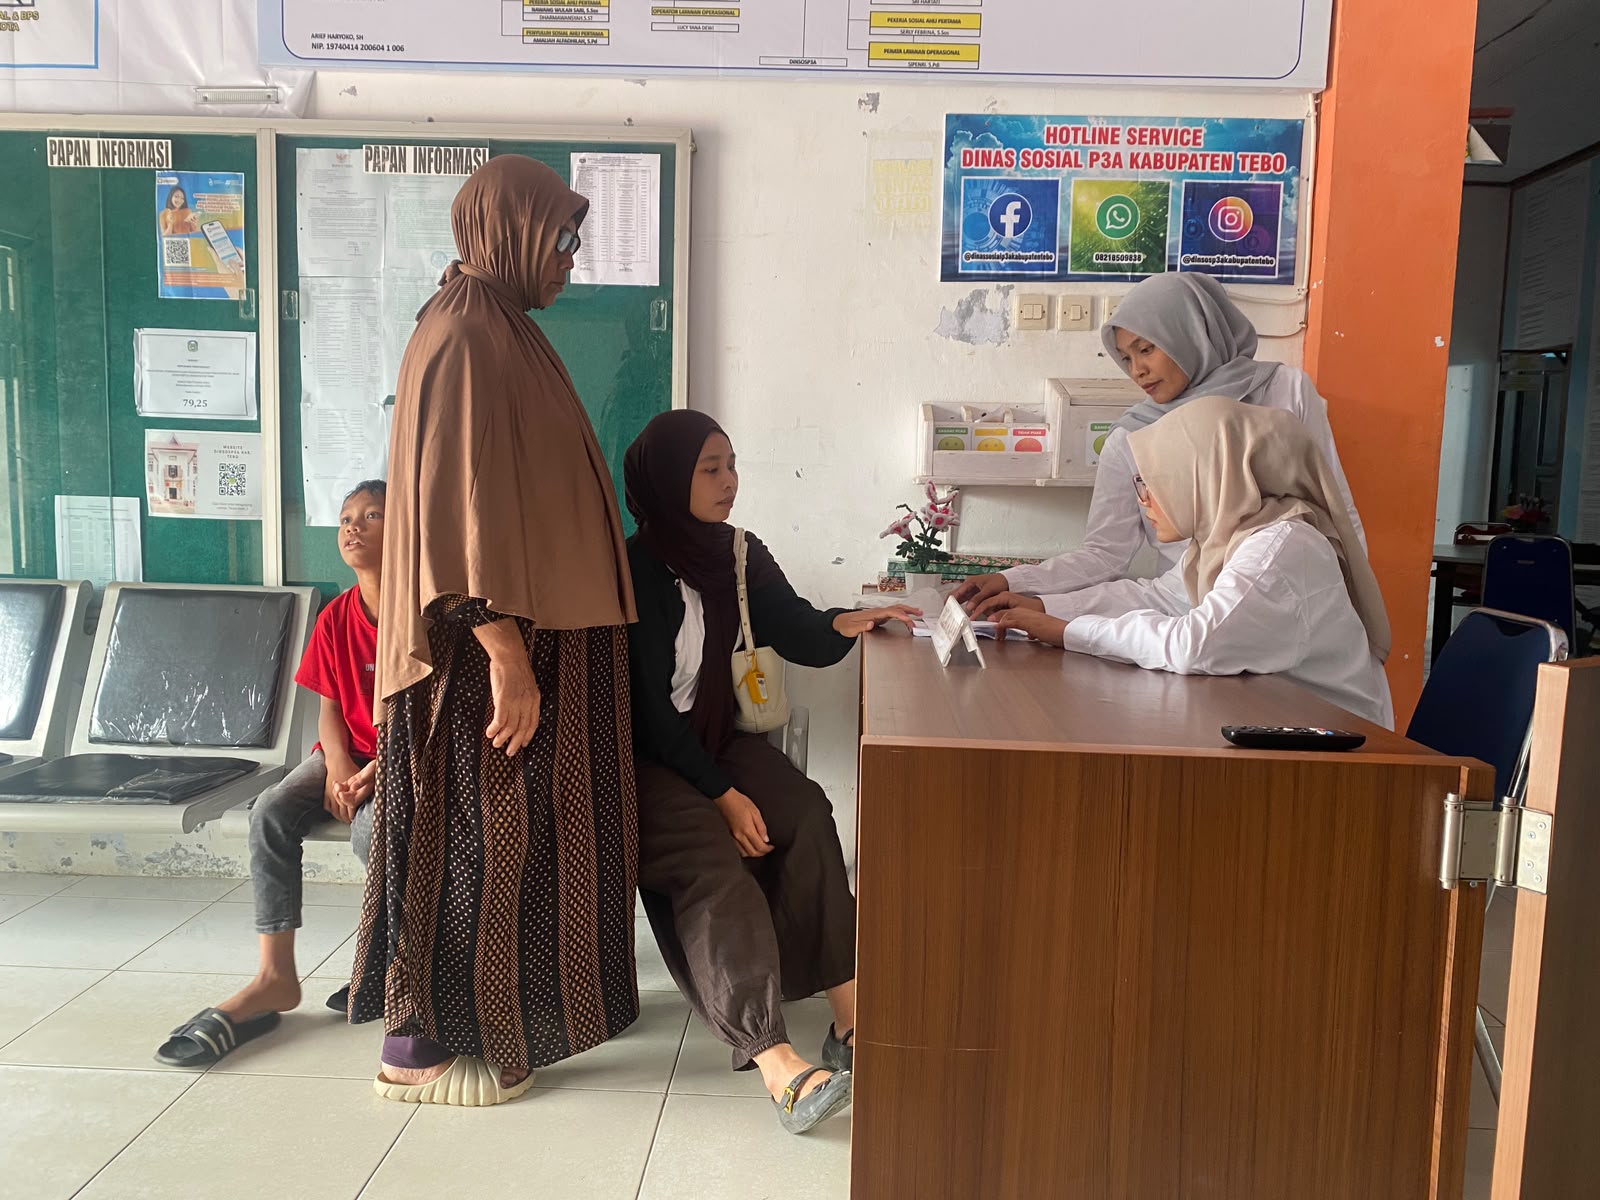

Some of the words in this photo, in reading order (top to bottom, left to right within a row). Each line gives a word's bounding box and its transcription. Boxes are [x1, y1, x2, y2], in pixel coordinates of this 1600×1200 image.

[20, 11, 39, 20] BPS
[1044, 126, 1121, 146] HOTLINE
[1126, 127, 1203, 147] SERVICE
[49, 139, 91, 166] PAPAN
[97, 140, 169, 168] INFORMASI
[364, 145, 407, 173] PAPAN
[413, 146, 487, 174] INFORMASI
[961, 149, 1016, 168] DINAS
[1020, 150, 1083, 169] SOSIAL
[1089, 151, 1124, 170] P3A
[1129, 152, 1233, 171] KABUPATEN
[1238, 153, 1287, 173] TEBO
[183, 399, 208, 408] 79,25
